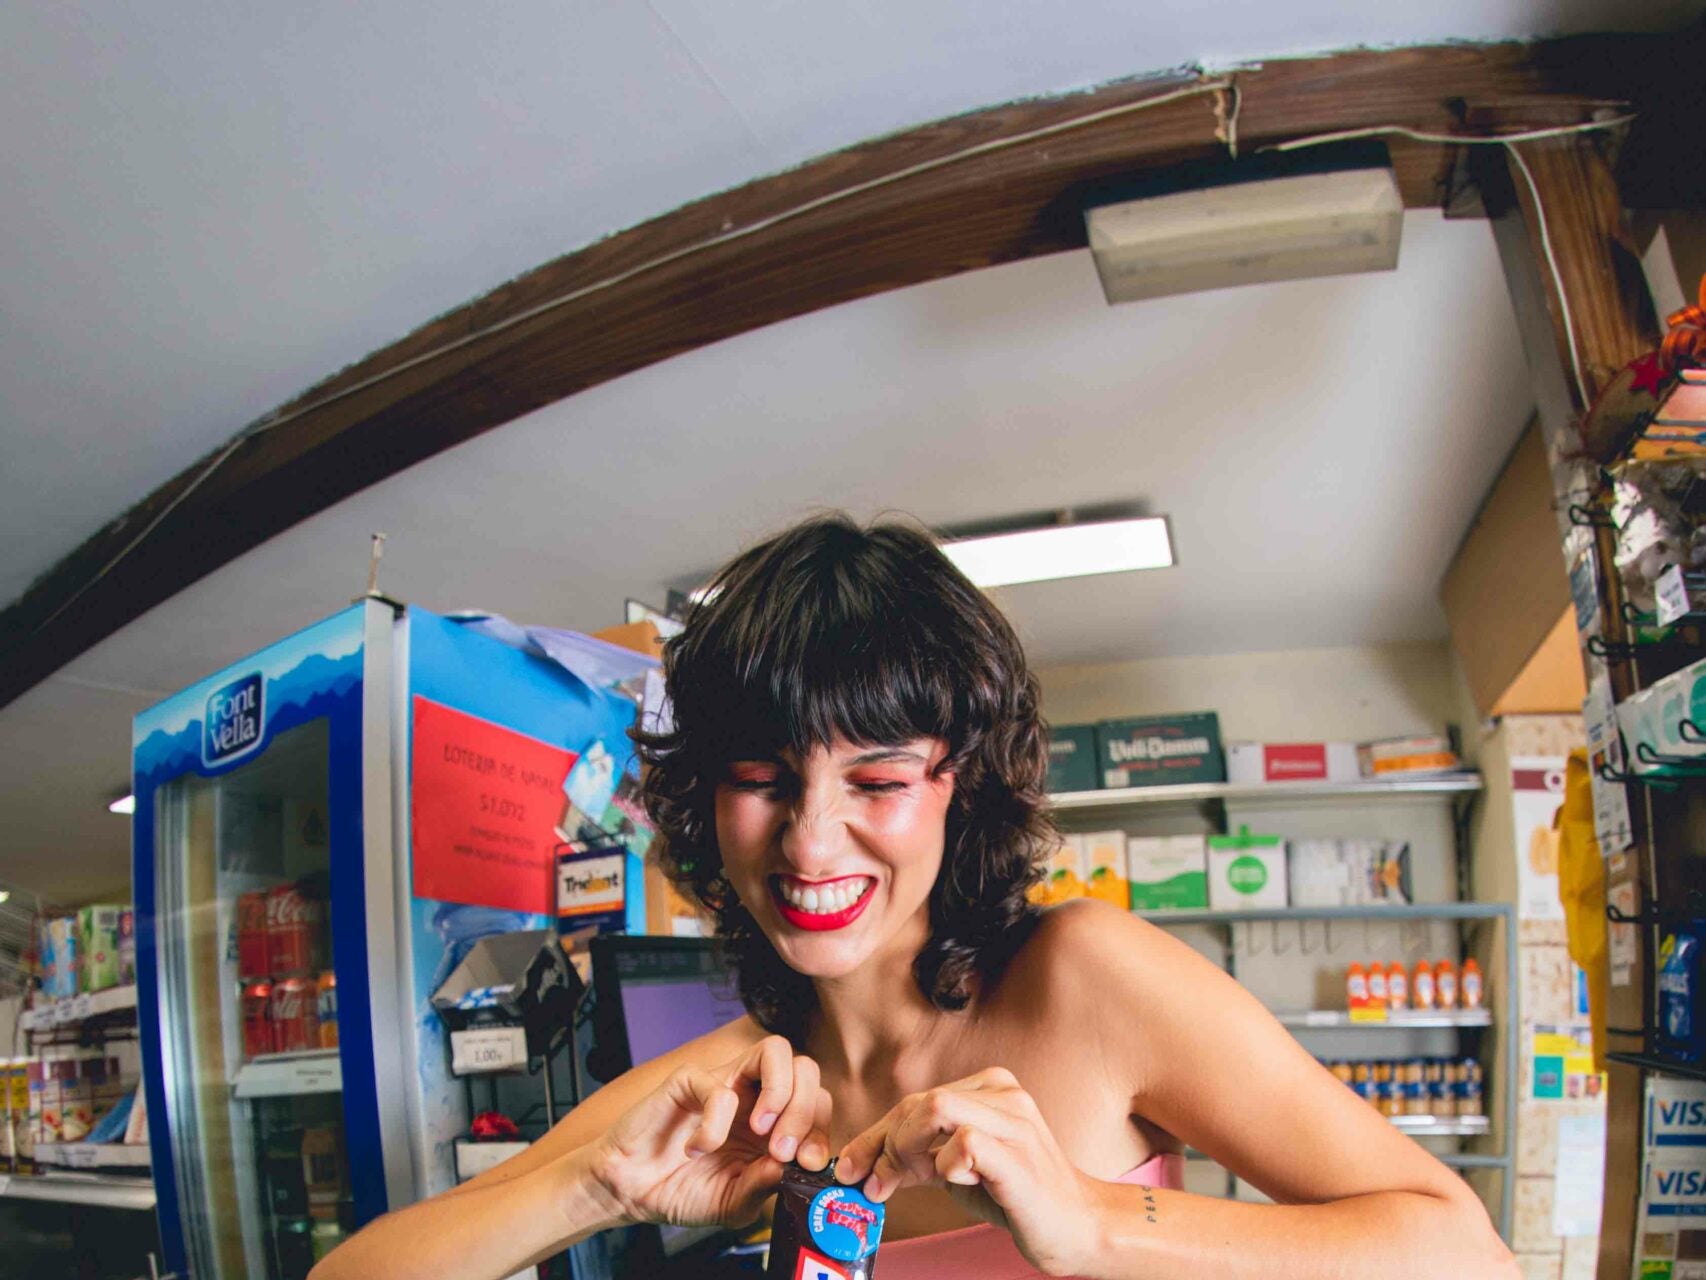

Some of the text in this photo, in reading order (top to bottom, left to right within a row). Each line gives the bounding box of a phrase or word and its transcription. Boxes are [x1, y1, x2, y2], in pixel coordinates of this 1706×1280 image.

[211, 684, 256, 725] Font
[210, 713, 256, 754] Vella
[1658, 1100, 1706, 1126] VIS
